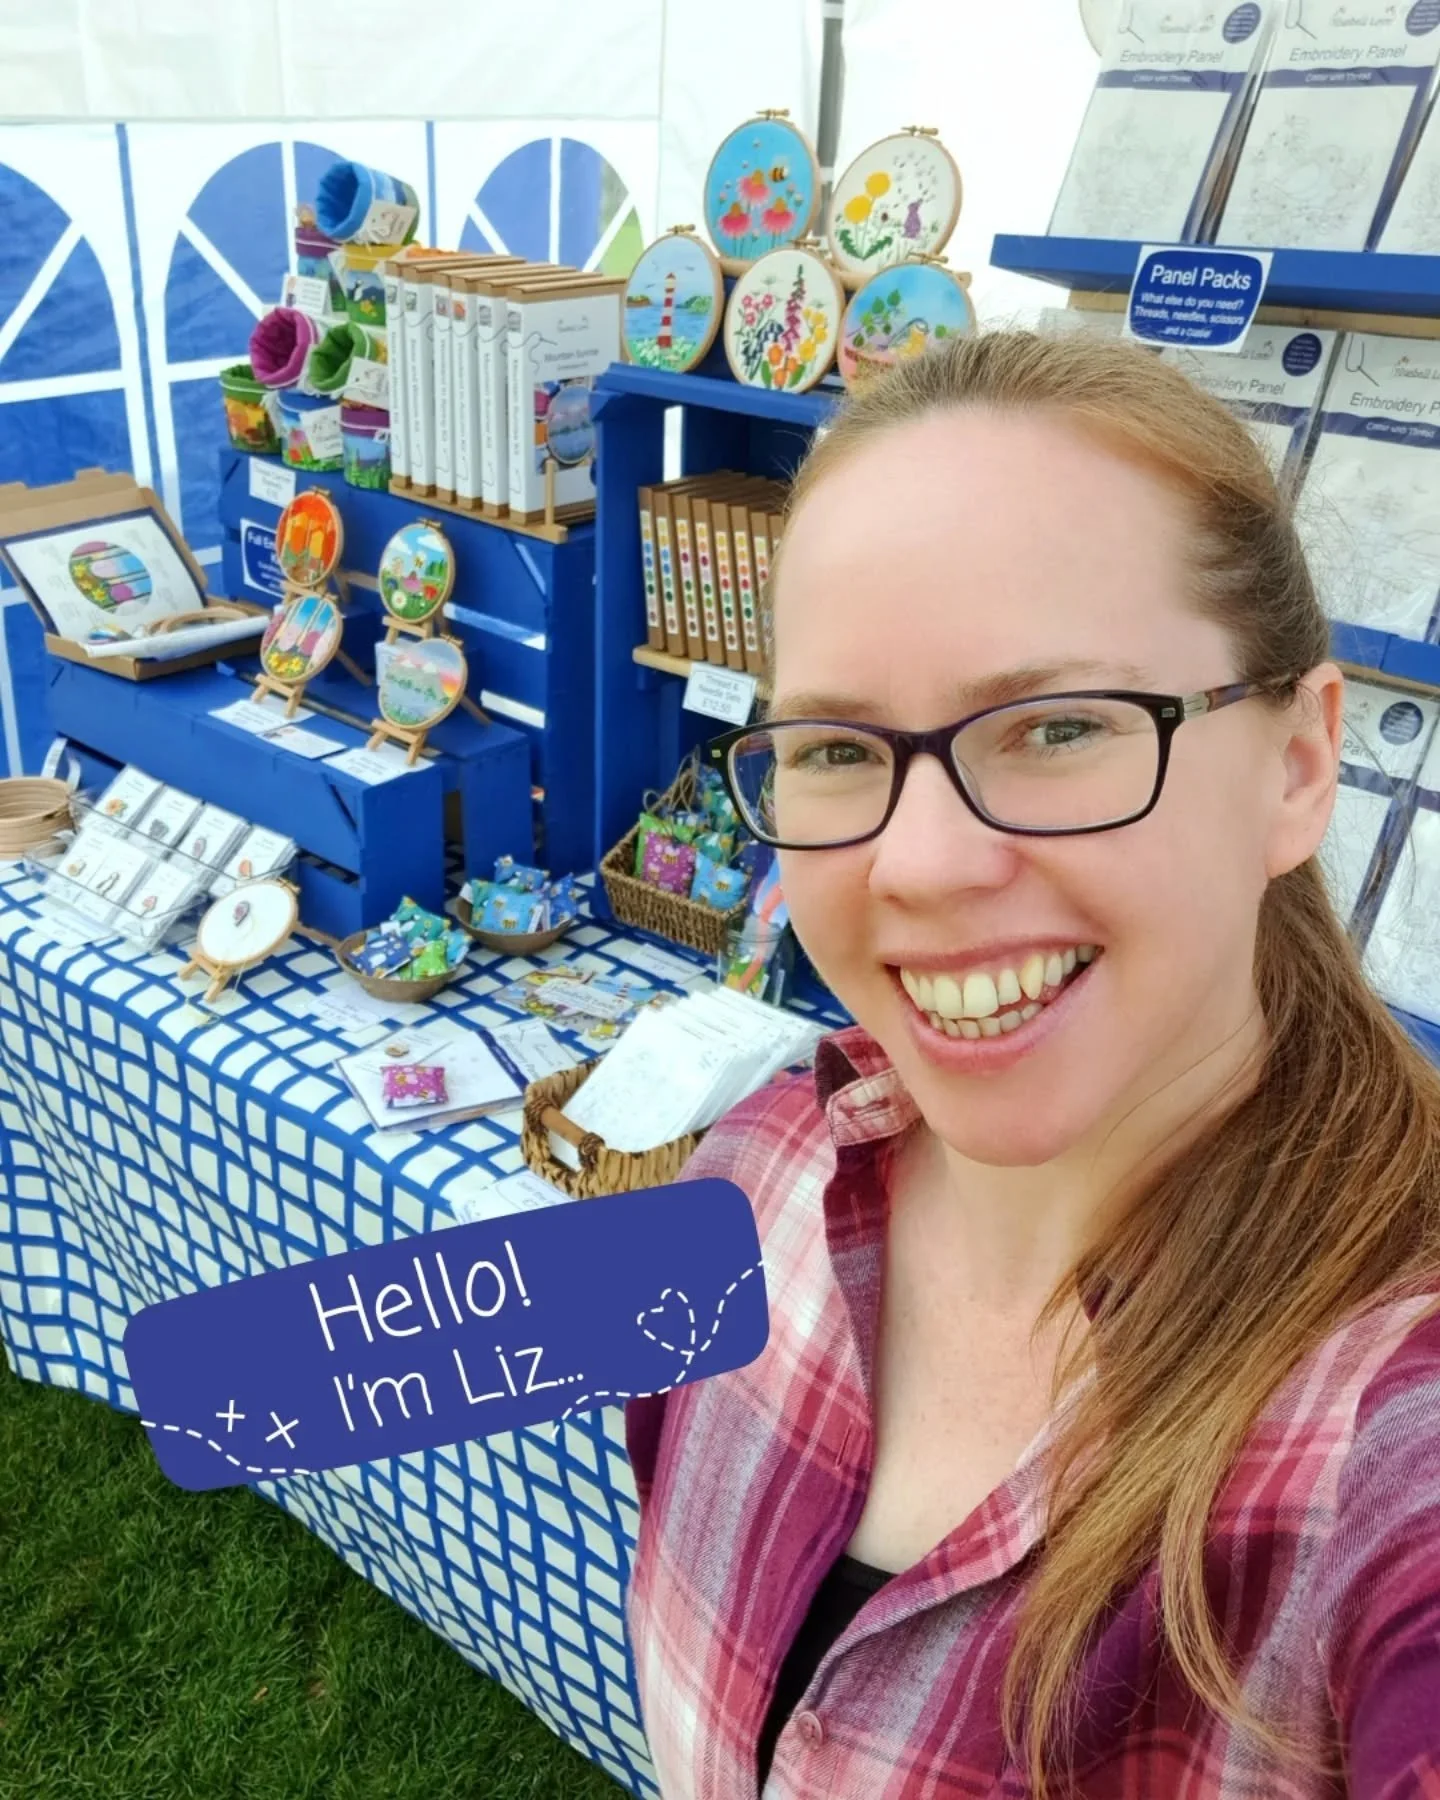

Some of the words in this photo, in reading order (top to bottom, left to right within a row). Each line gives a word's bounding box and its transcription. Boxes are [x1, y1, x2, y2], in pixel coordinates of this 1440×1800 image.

[1120, 50, 1186, 65] Embroidery
[1187, 49, 1224, 63] Panel
[1289, 46, 1365, 62] Embroidery
[1366, 44, 1408, 59] Panel
[1150, 264, 1197, 287] Panel
[1200, 267, 1252, 290] Packs
[1141, 292, 1164, 304] What
[1164, 295, 1183, 306] else
[1184, 295, 1197, 307] do
[1197, 298, 1214, 310] you
[1215, 299, 1244, 311] need?
[1134, 305, 1169, 321] Threads,
[1172, 311, 1207, 323] needles,
[1208, 314, 1245, 326] scissors
[1250, 378, 1286, 395] Panel
[1349, 392, 1426, 416] Embroidery
